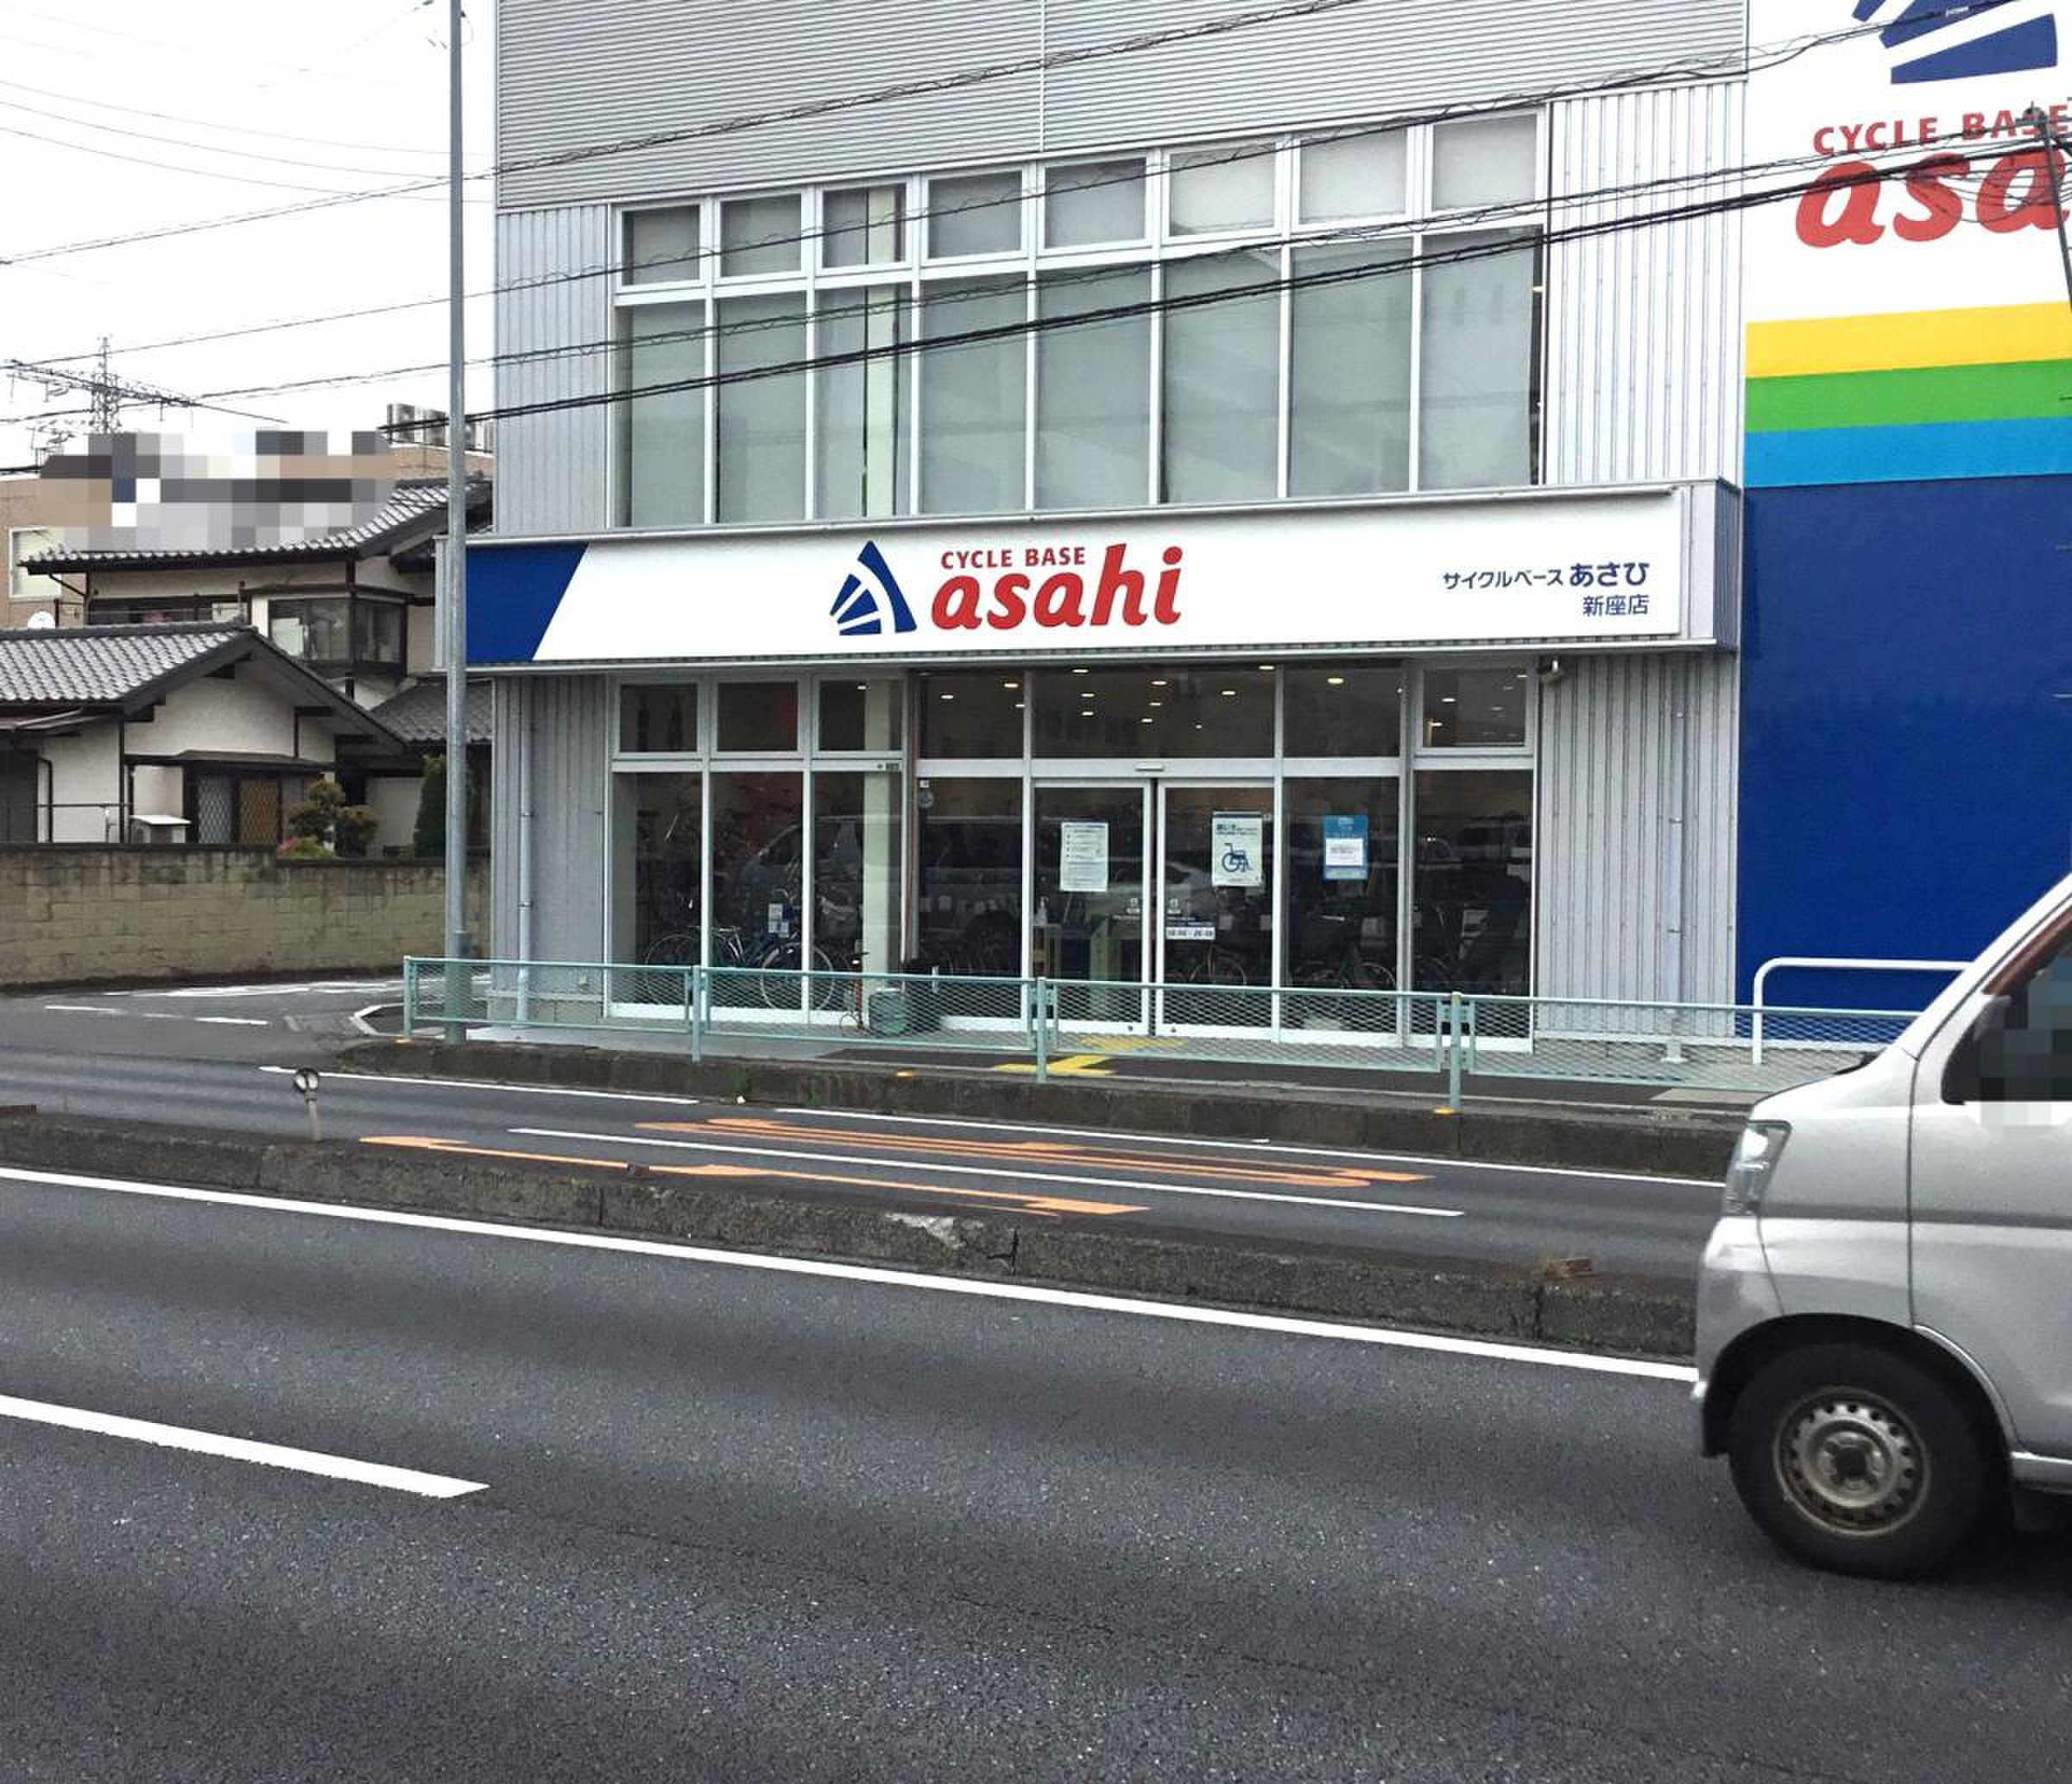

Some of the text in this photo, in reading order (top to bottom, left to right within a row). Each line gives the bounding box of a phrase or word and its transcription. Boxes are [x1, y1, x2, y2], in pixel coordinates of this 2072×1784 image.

[1813, 117, 1937, 156] CYCLE
[940, 547, 1086, 570] CYCLE BASE
[931, 542, 1184, 630] asahi
[1582, 593, 1651, 617] 新座店
